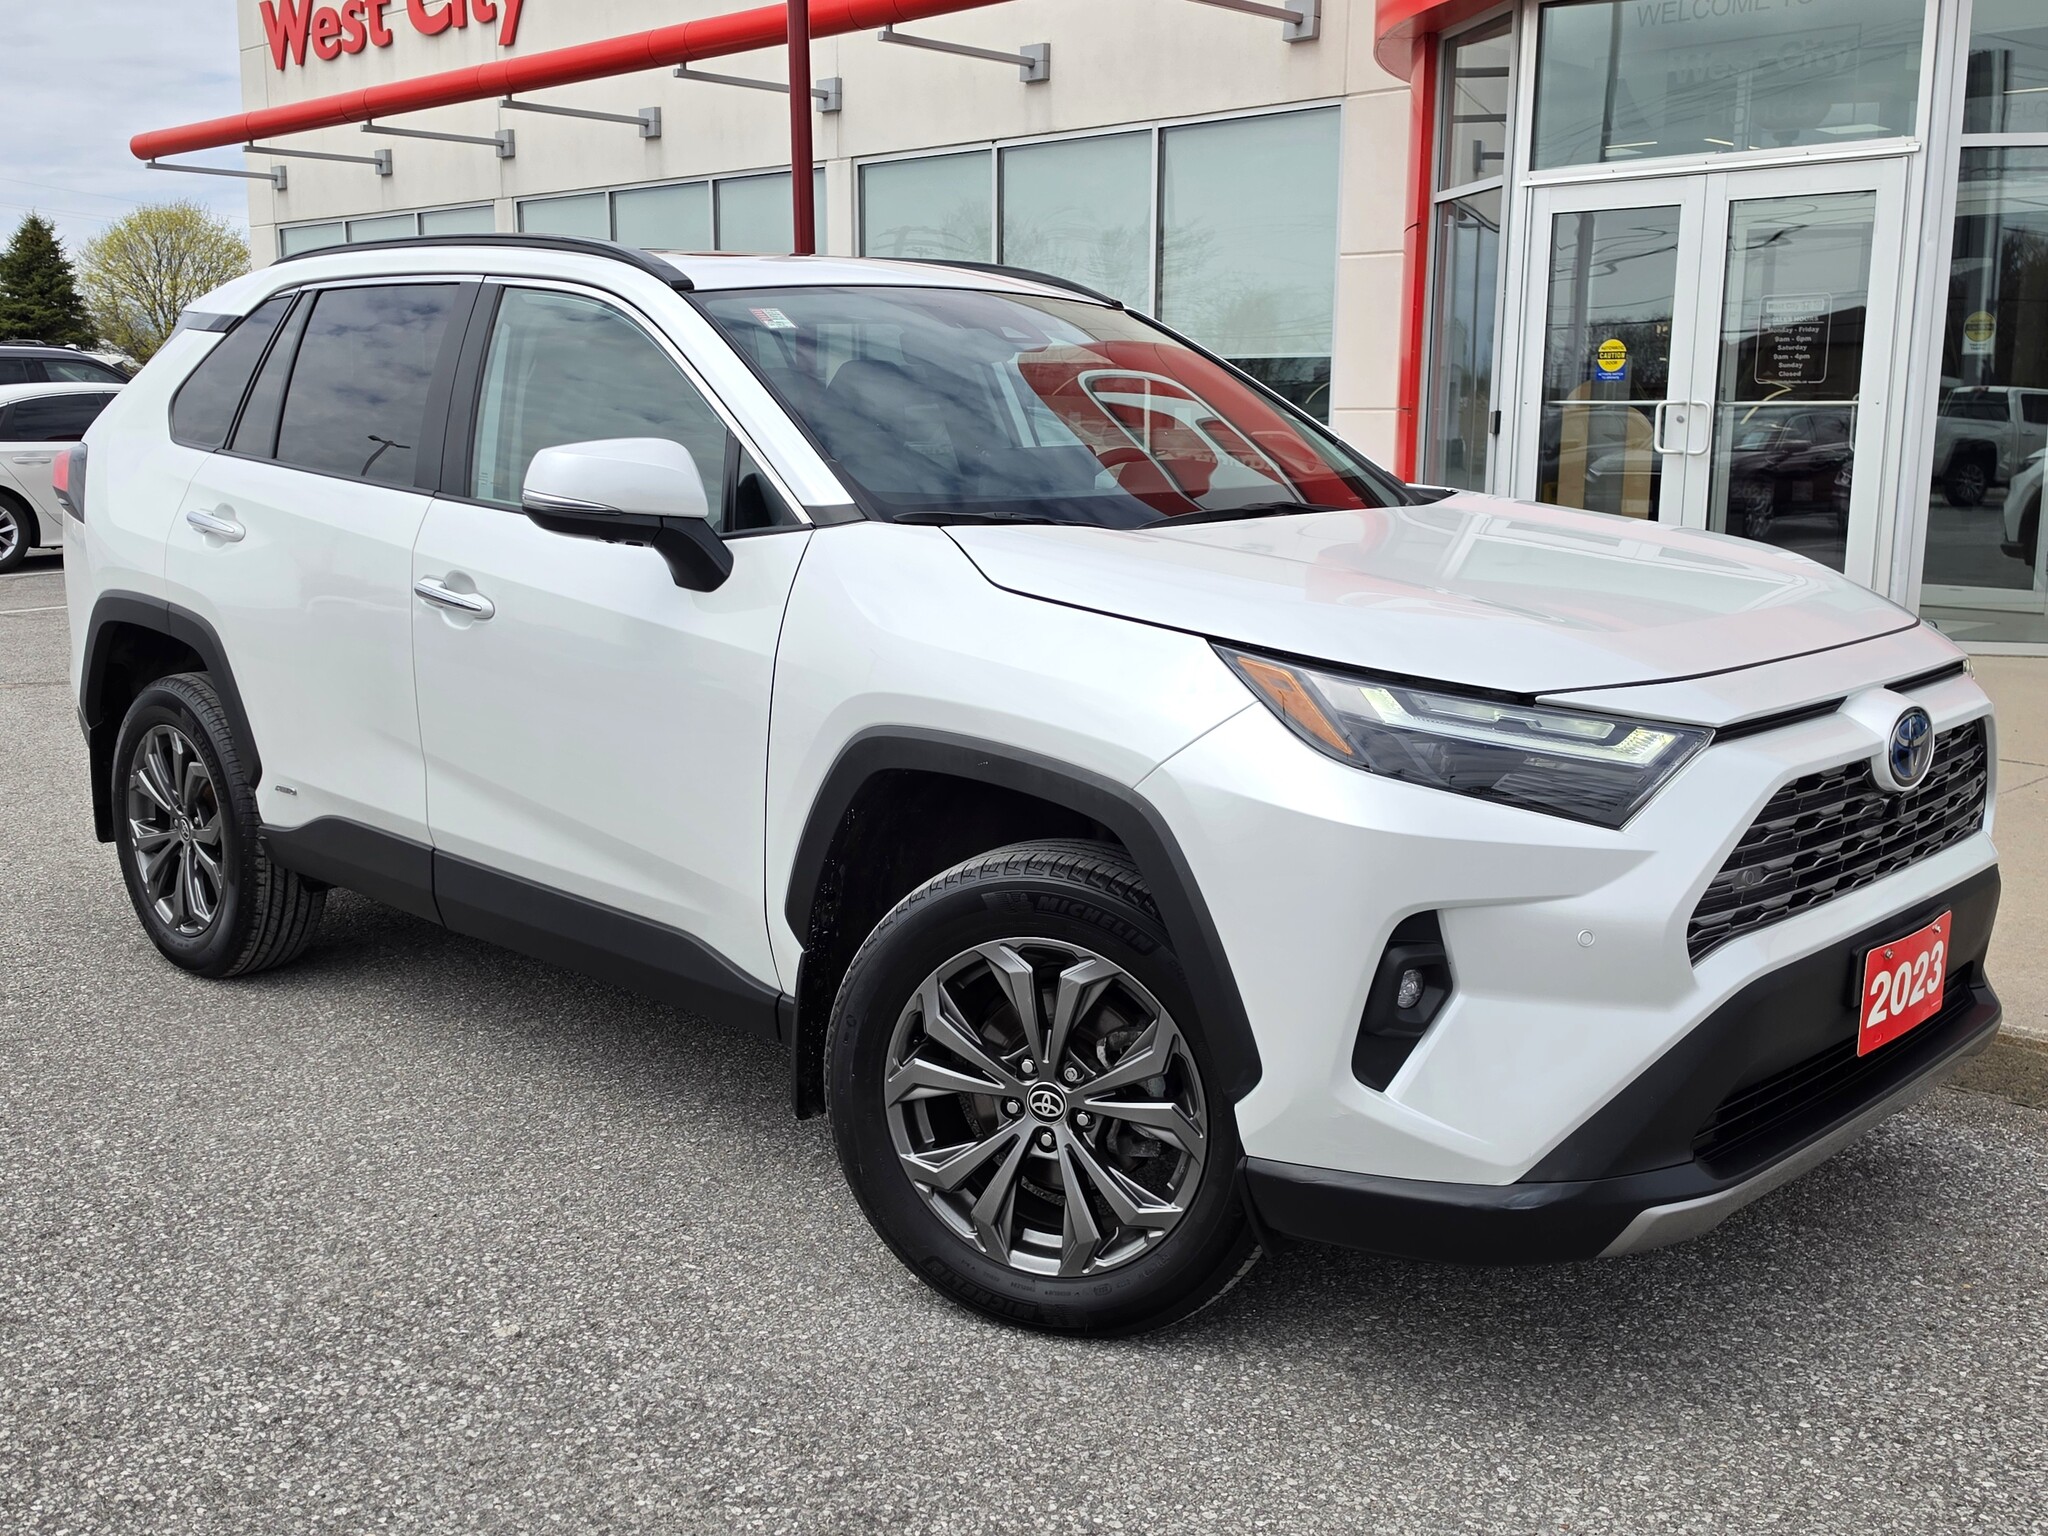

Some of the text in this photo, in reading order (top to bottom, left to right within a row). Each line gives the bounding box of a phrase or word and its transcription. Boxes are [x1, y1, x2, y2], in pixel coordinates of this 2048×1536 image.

[259, 0, 393, 71] West
[1794, 353, 1811, 361] 4pm
[1796, 335, 1812, 343] 6pm
[1035, 894, 1155, 954] MICHELIN
[1866, 940, 1944, 1029] 2023
